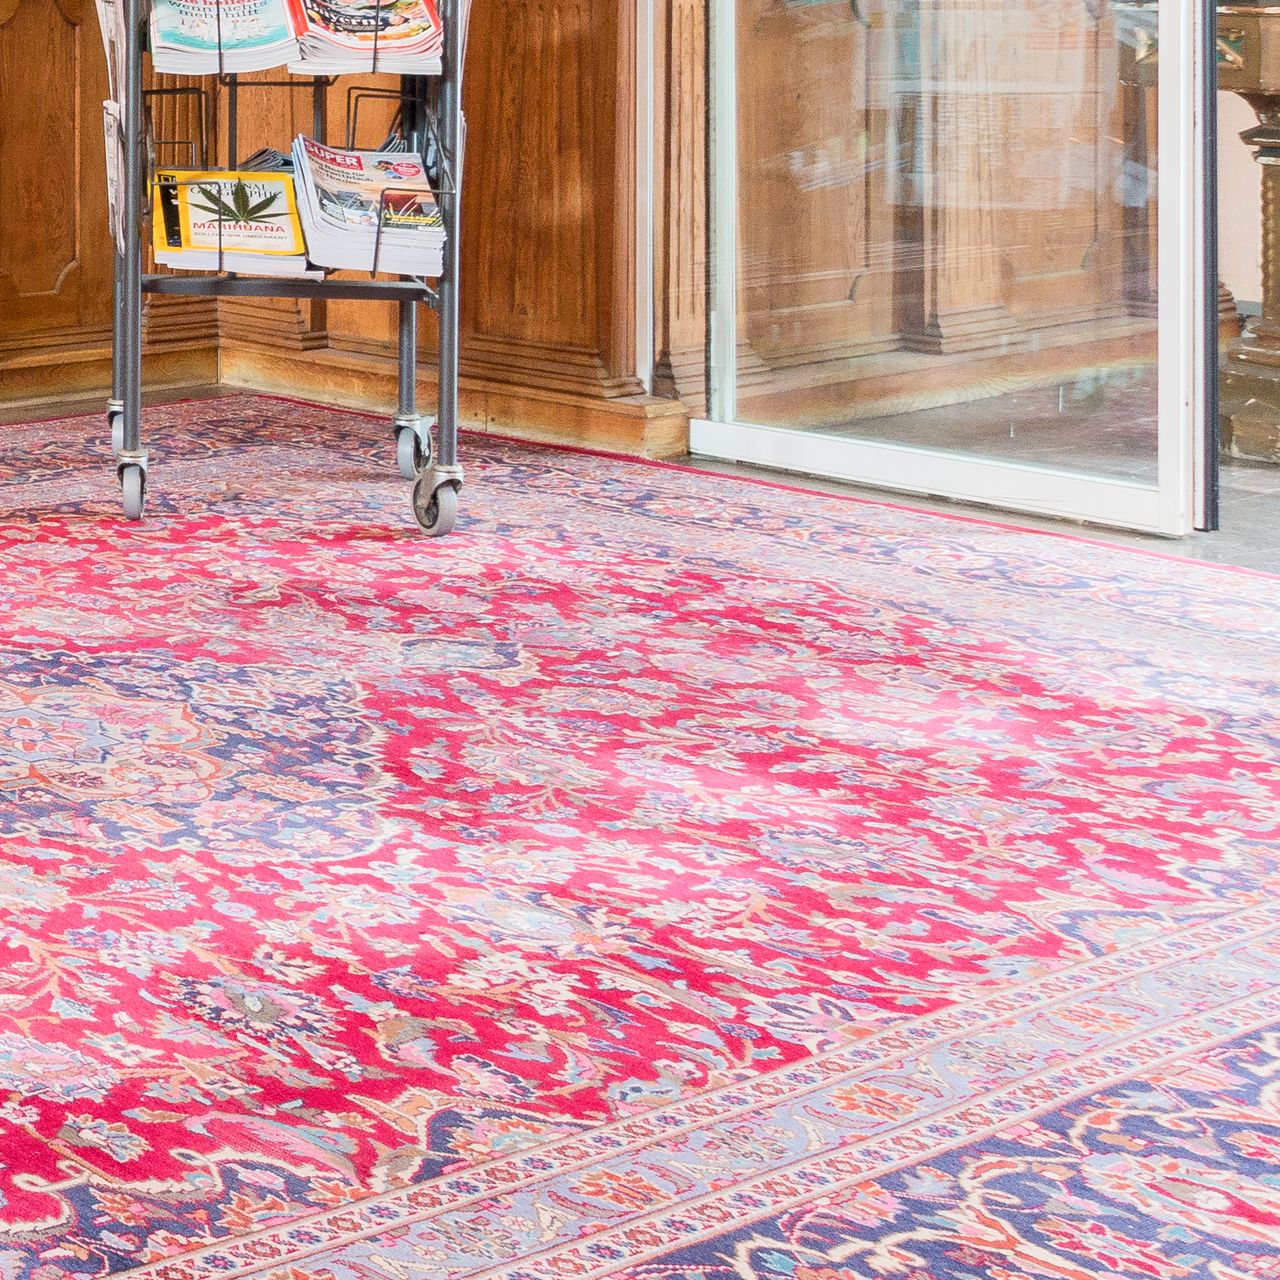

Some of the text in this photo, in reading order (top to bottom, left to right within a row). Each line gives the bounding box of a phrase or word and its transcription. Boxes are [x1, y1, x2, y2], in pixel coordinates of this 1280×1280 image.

[168, 0, 268, 13] wenn nichts
[225, 8, 261, 19] hilft
[304, 140, 359, 166] SUPER
[192, 222, 285, 233] MARIHUANA
